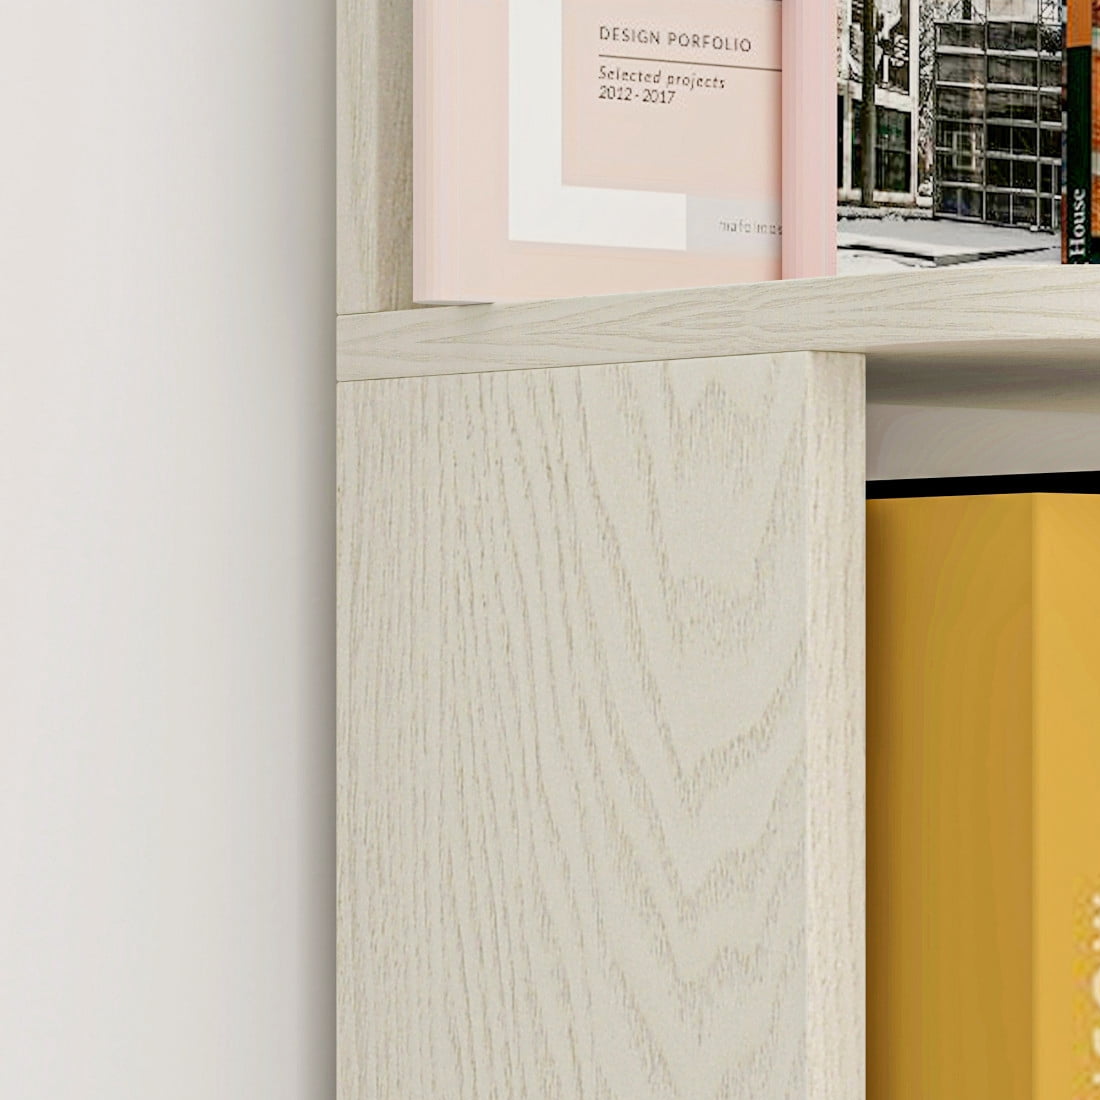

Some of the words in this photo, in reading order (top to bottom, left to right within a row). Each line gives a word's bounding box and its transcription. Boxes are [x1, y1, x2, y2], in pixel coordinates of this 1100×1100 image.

[599, 26, 660, 44] DESIGN
[668, 32, 751, 52] PORFOLIO
[599, 65, 661, 84] Selected
[667, 72, 725, 91] projects
[1069, 188, 1086, 257] House
